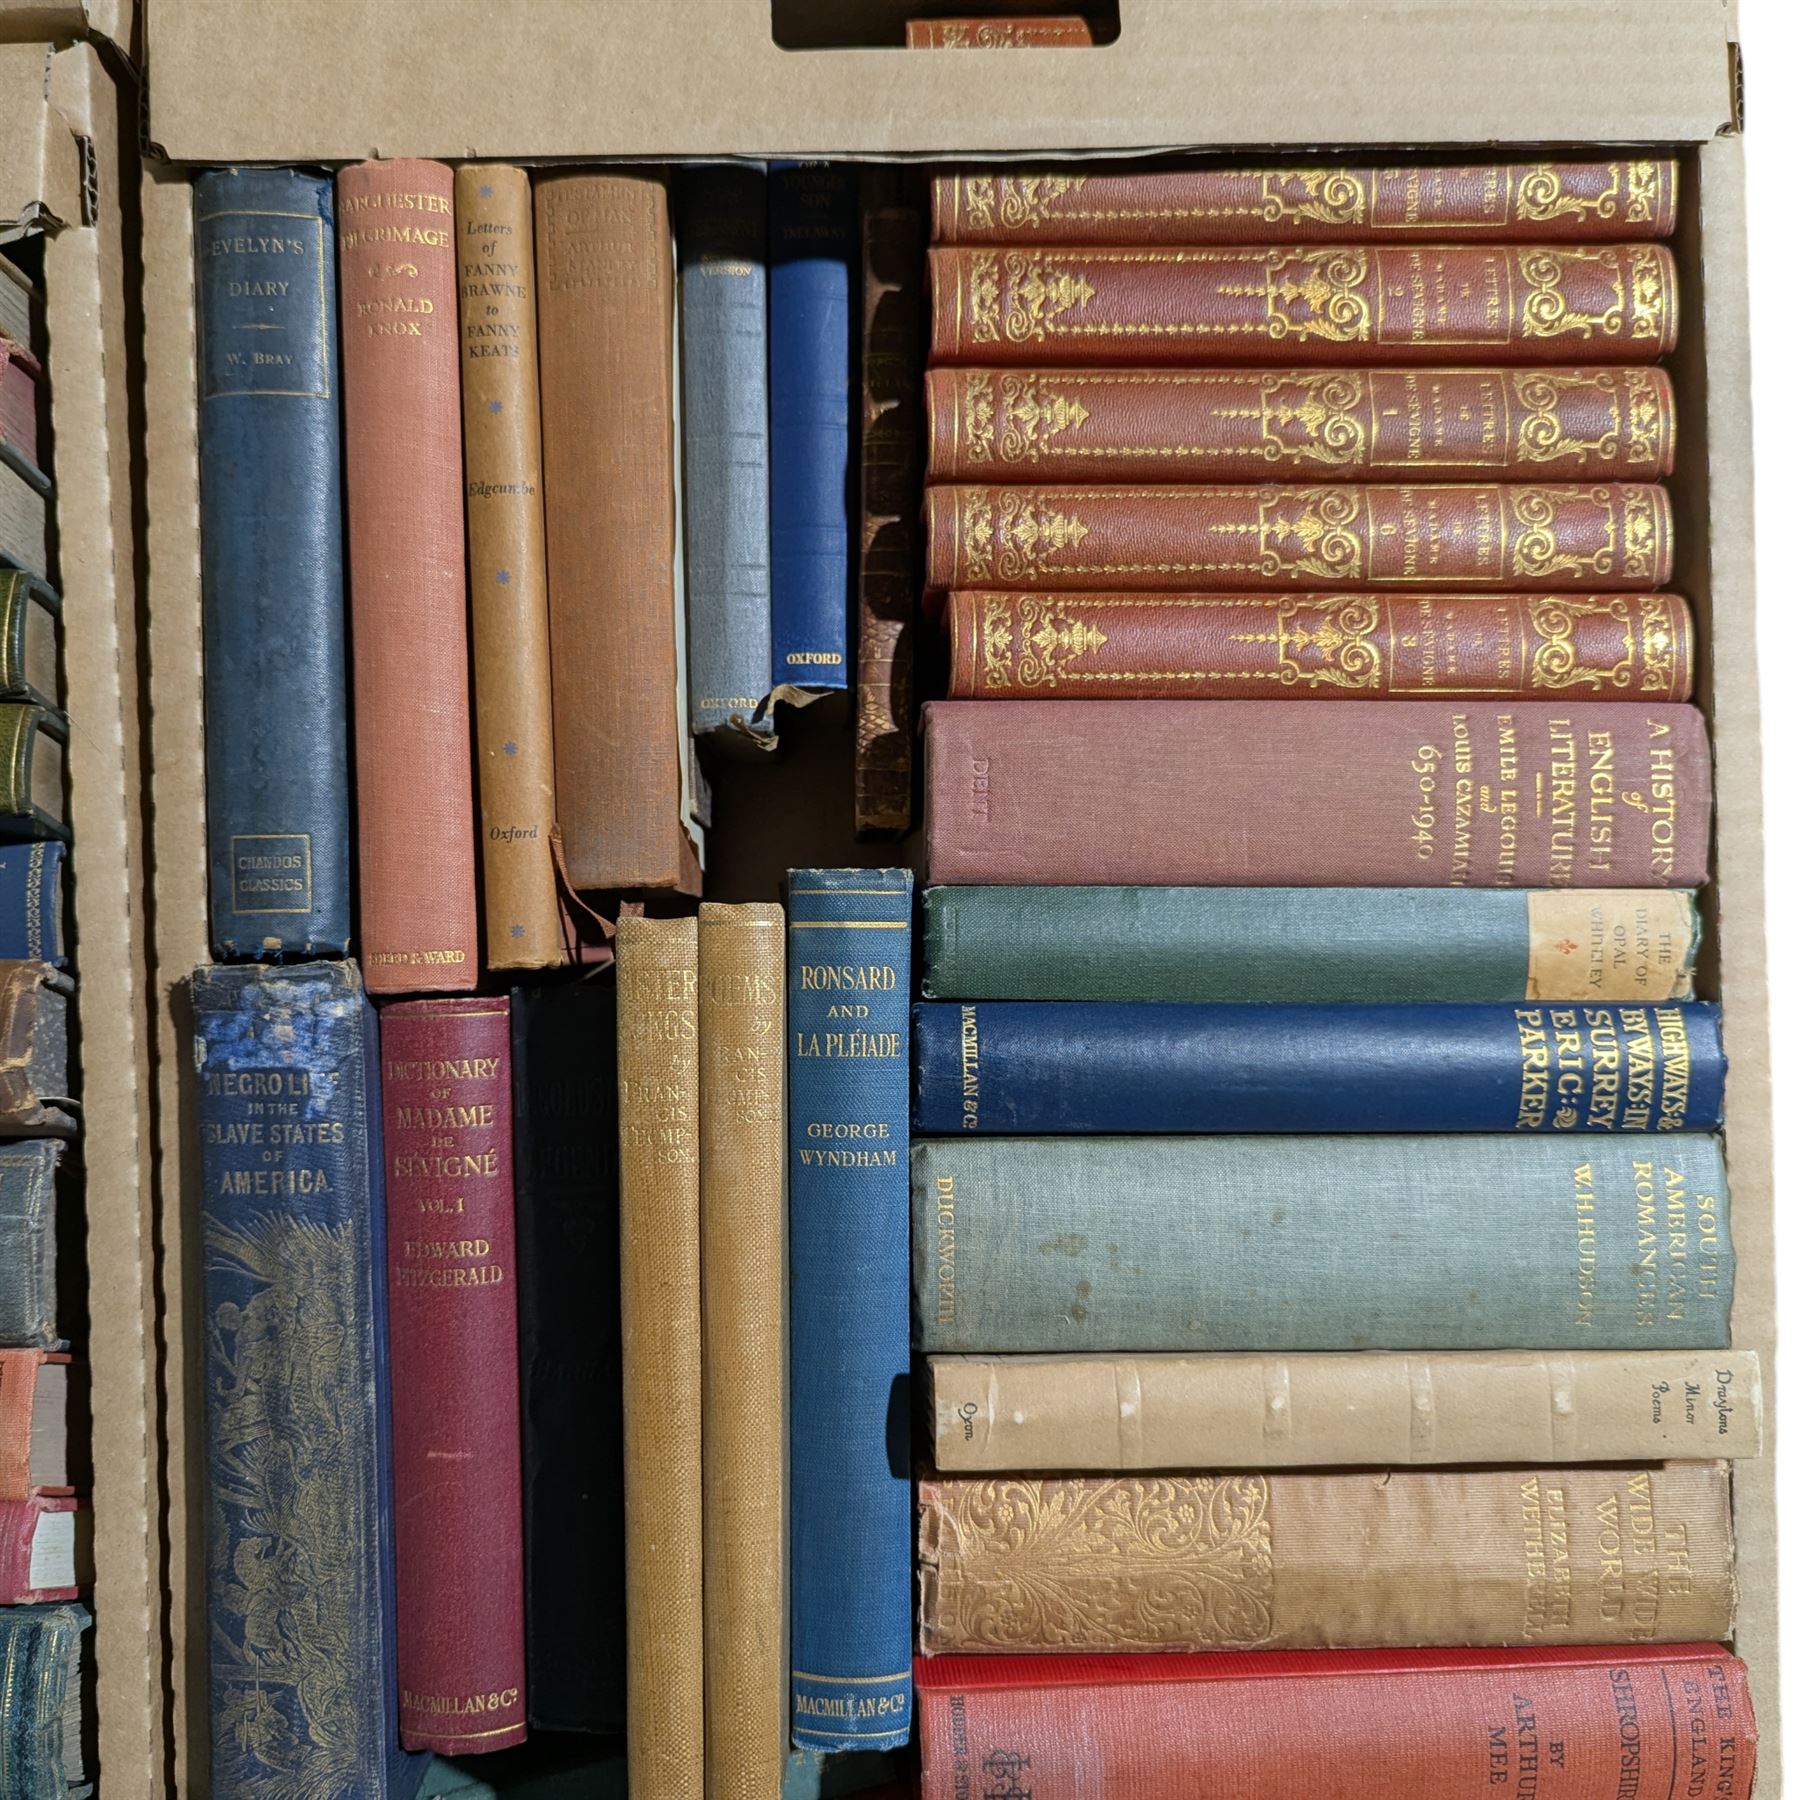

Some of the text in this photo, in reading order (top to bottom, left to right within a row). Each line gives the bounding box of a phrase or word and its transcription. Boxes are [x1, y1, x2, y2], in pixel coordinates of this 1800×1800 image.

[341, 226, 450, 250] PILGRIMAGE
[466, 222, 513, 235] Letters
[212, 238, 304, 256] EVELYN'S
[482, 240, 499, 256] of
[464, 263, 519, 279] FANNY
[230, 282, 290, 297] DIARY
[461, 283, 527, 299] BRAWNE
[357, 299, 434, 317] RONALD
[486, 304, 499, 317] to
[368, 322, 422, 338] KNOX
[467, 324, 521, 340] FANNY
[1380, 524, 1397, 536] 6
[786, 653, 842, 665] OXFORD
[1452, 714, 1473, 773] LOUIS
[1497, 714, 1519, 782] EMILE
[1479, 785, 1497, 814] and
[1587, 730, 1614, 871] ENGLISH
[1621, 790, 1649, 813] of
[1646, 719, 1677, 887] A HISTORY
[490, 825, 538, 844] Oxford
[239, 855, 302, 871] CHANDOS
[240, 878, 303, 892] CLASSICS
[424, 950, 466, 964] WARD
[1613, 925, 1627, 969] OPAL
[1634, 908, 1649, 986] DIARY OF
[1658, 931, 1672, 965] THE
[801, 966, 896, 990] RONSARD
[827, 1005, 869, 1018] AND
[797, 1028, 901, 1058] LA PLÉIADE
[961, 1005, 979, 1096] MACMILLAN
[387, 1057, 500, 1081] DICTIONARY
[1514, 1009, 1550, 1129] PARKER
[1583, 1008, 1621, 1129] SURREY
[207, 1072, 283, 1097] NEGRO
[431, 1087, 452, 1099] OF
[248, 1103, 299, 1116] IN THE
[397, 1104, 494, 1129] MADAME
[207, 1122, 346, 1145] SLAVE STATES
[431, 1136, 455, 1148] DE
[807, 1123, 890, 1138] GEORGE
[263, 1150, 283, 1162] OF
[800, 1150, 897, 1167] WYNDHAM
[404, 1239, 490, 1258] EDWARD
[936, 1176, 955, 1325] DUCKWORTH
[1631, 1160, 1658, 1328] ROMANCES
[1663, 1167, 1687, 1321] AMERICAN
[1696, 1195, 1719, 1299] SOUTH
[397, 1264, 504, 1287] FITZGERALD
[1652, 1381, 1672, 1424] Poems
[1684, 1381, 1701, 1424] Minor
[1547, 1488, 1571, 1628] ELIZABETH
[1594, 1495, 1625, 1622] WORLD
[1627, 1472, 1661, 1641] WIDE WIDE
[1664, 1524, 1691, 1595] THE
[403, 1690, 485, 1713] MACMILLAN
[487, 1692, 499, 1711] &
[1707, 1665, 1734, 1720] THE
[796, 1694, 876, 1717] MACMILLAN
[878, 1696, 890, 1715] &
[1681, 1679, 1707, 1798] ENGLAND
[1487, 1726, 1509, 1785] MEE
[1549, 1741, 1565, 1769] BY
